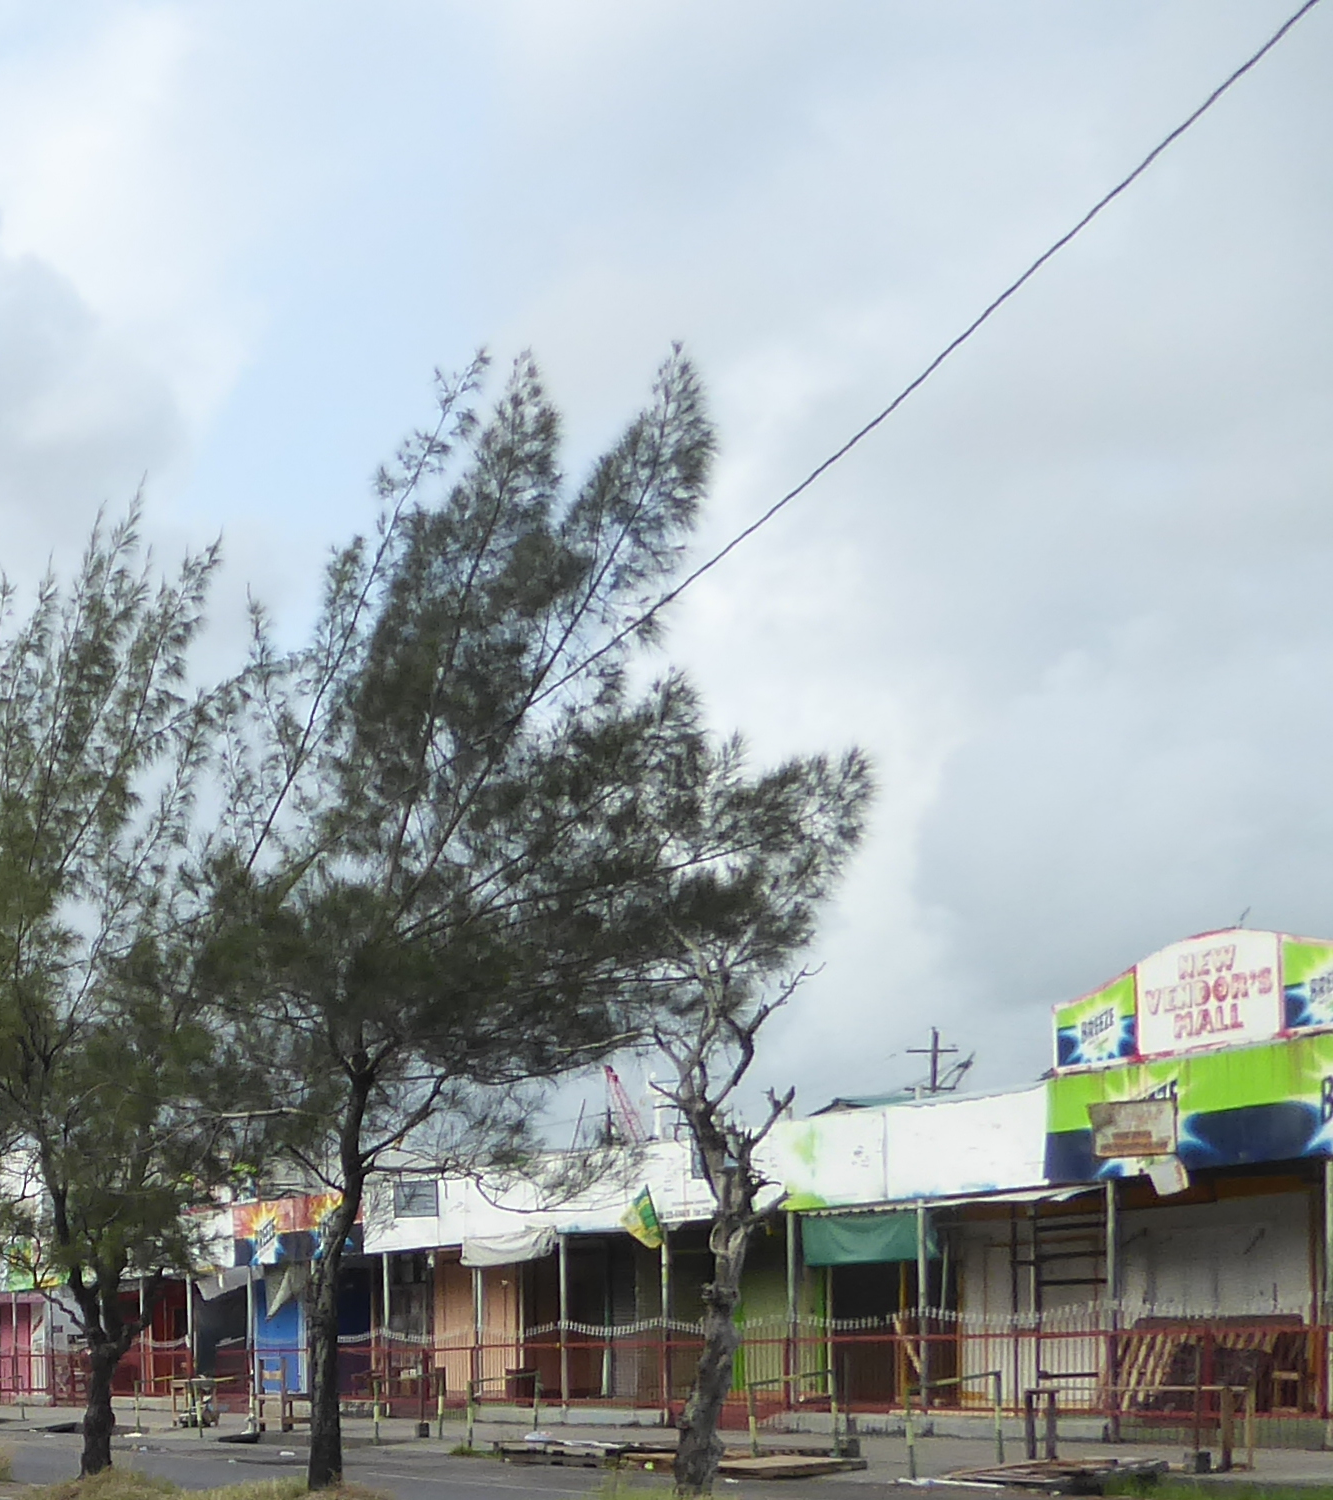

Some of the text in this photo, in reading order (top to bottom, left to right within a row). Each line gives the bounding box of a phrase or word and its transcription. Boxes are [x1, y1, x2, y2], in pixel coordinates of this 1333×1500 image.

[1178, 944, 1237, 980] NEW
[1144, 967, 1274, 1016] VENDOR'S
[1173, 1003, 1245, 1039] MALL
